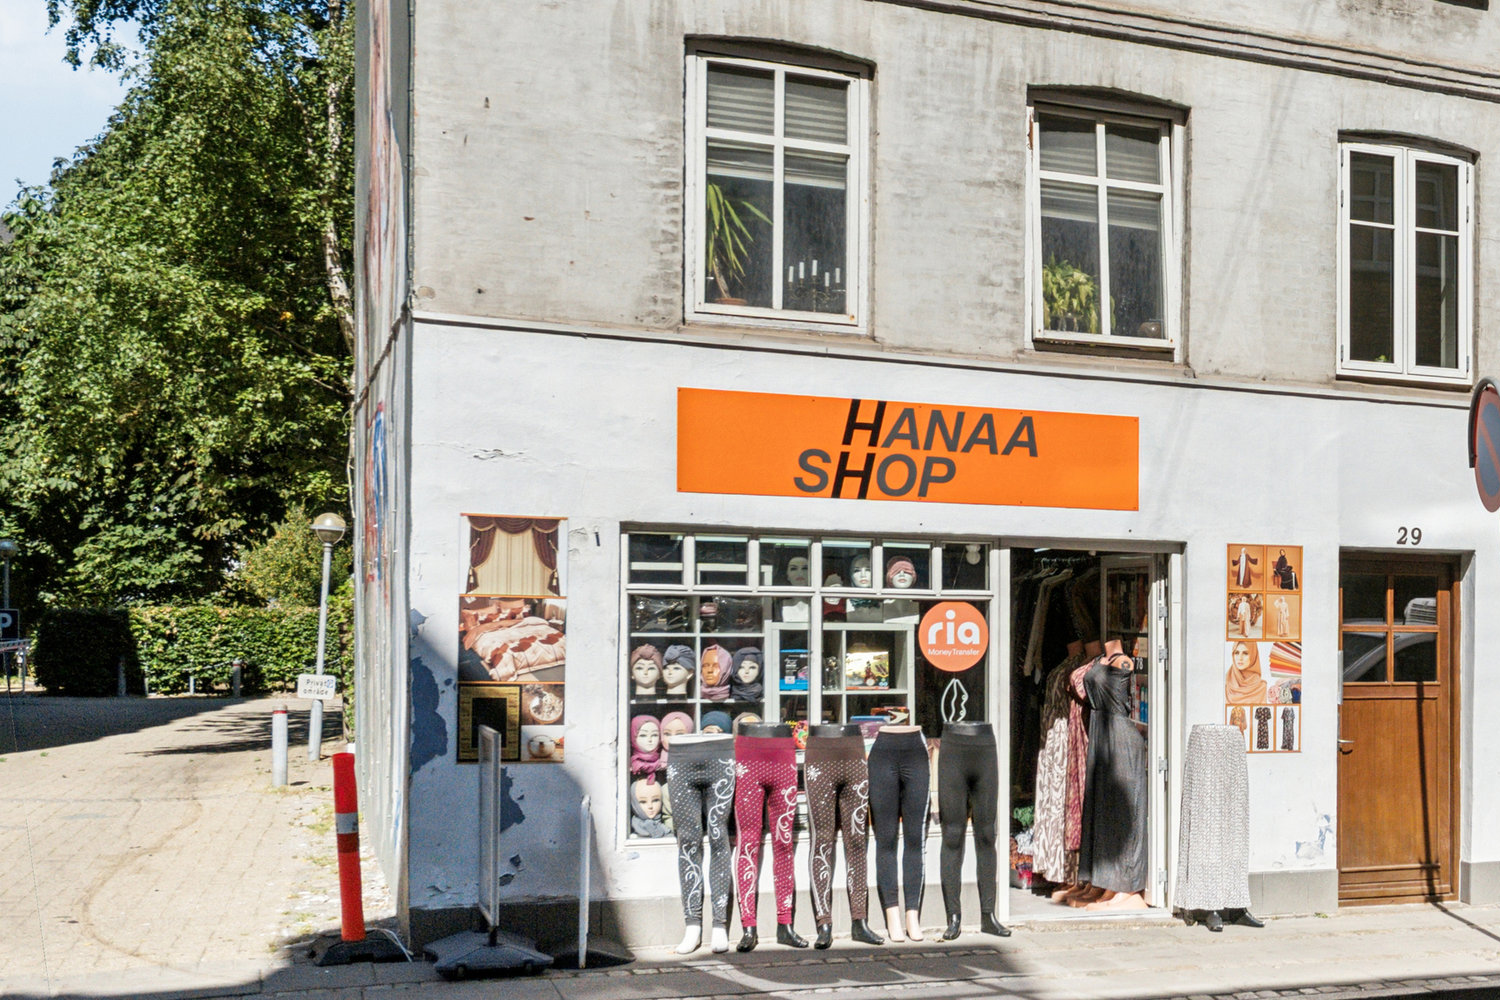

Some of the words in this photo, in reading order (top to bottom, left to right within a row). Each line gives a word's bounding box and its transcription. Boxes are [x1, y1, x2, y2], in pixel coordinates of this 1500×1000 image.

[841, 398, 1039, 458] HANAA
[793, 448, 957, 500] SHOP
[1396, 526, 1422, 546] 29
[928, 609, 980, 645] ria
